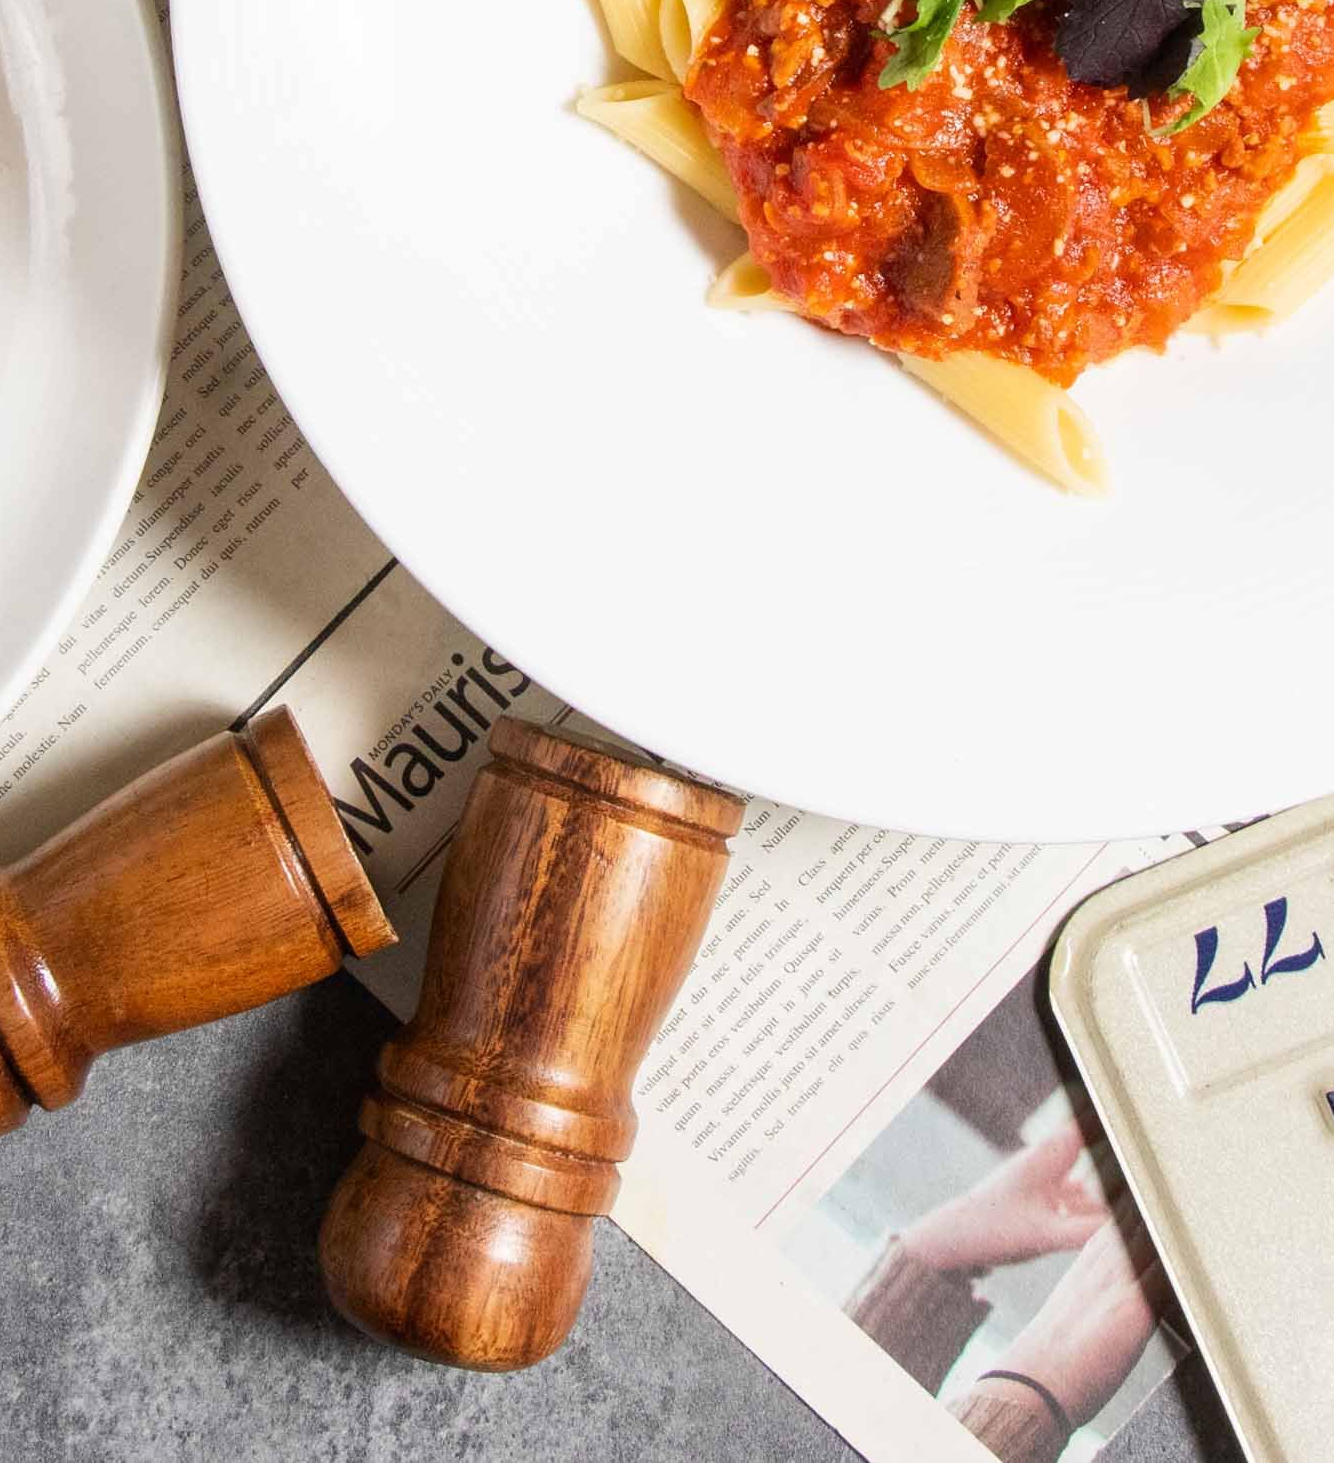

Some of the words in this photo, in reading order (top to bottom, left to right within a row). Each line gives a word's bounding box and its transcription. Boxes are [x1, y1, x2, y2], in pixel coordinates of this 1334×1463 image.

[180, 347, 215, 384] mollis
[195, 374, 221, 399] Sed
[216, 392, 242, 418] quis
[145, 449, 185, 490] congue
[183, 423, 208, 451] orci
[234, 412, 257, 436] nec
[133, 475, 195, 539] ullamcorper
[191, 443, 227, 478] mattis
[289, 465, 311, 490] per
[56, 633, 79, 656] dui
[80, 602, 109, 631] vitae
[208, 461, 245, 498] iaculis
[75, 609, 139, 676] pellentesque
[173, 534, 213, 572] Donec
[210, 508, 237, 535] eget
[235, 480, 264, 508] risus
[150, 579, 202, 633] consequat
[198, 559, 221, 582] dui
[244, 496, 282, 535] rutrum
[56, 701, 88, 732] Nam
[335, 644, 534, 856] Mauris
[366, 700, 425, 761] MONDAY'S
[421, 668, 455, 704] DAILY
[760, 813, 801, 854] Nullam
[796, 857, 828, 889] Class
[814, 860, 859, 906] torquent
[887, 938, 923, 974] Fusce
[951, 878, 979, 907] nunc
[698, 933, 723, 959] eget
[869, 921, 904, 956] massa
[1190, 896, 1327, 1015] 77
[636, 1053, 679, 1097] volutpat
[676, 1029, 701, 1056] ante
[714, 985, 742, 1015] amet
[739, 961, 766, 987] felis
[653, 1085, 682, 1114] vitae
[678, 1057, 709, 1089] porta
[705, 1033, 732, 1060] eros
[782, 930, 827, 976] Quisque
[671, 1099, 703, 1132] quam
[740, 1015, 781, 1058] suscipit
[796, 967, 827, 998] justo
[719, 1058, 775, 1117] scelerisque
[773, 1000, 829, 1058] vestibulum
[706, 1117, 753, 1164] Vivamus
[748, 1085, 783, 1121] mollis
[778, 1059, 807, 1090] justo
[816, 1019, 845, 1049] amet
